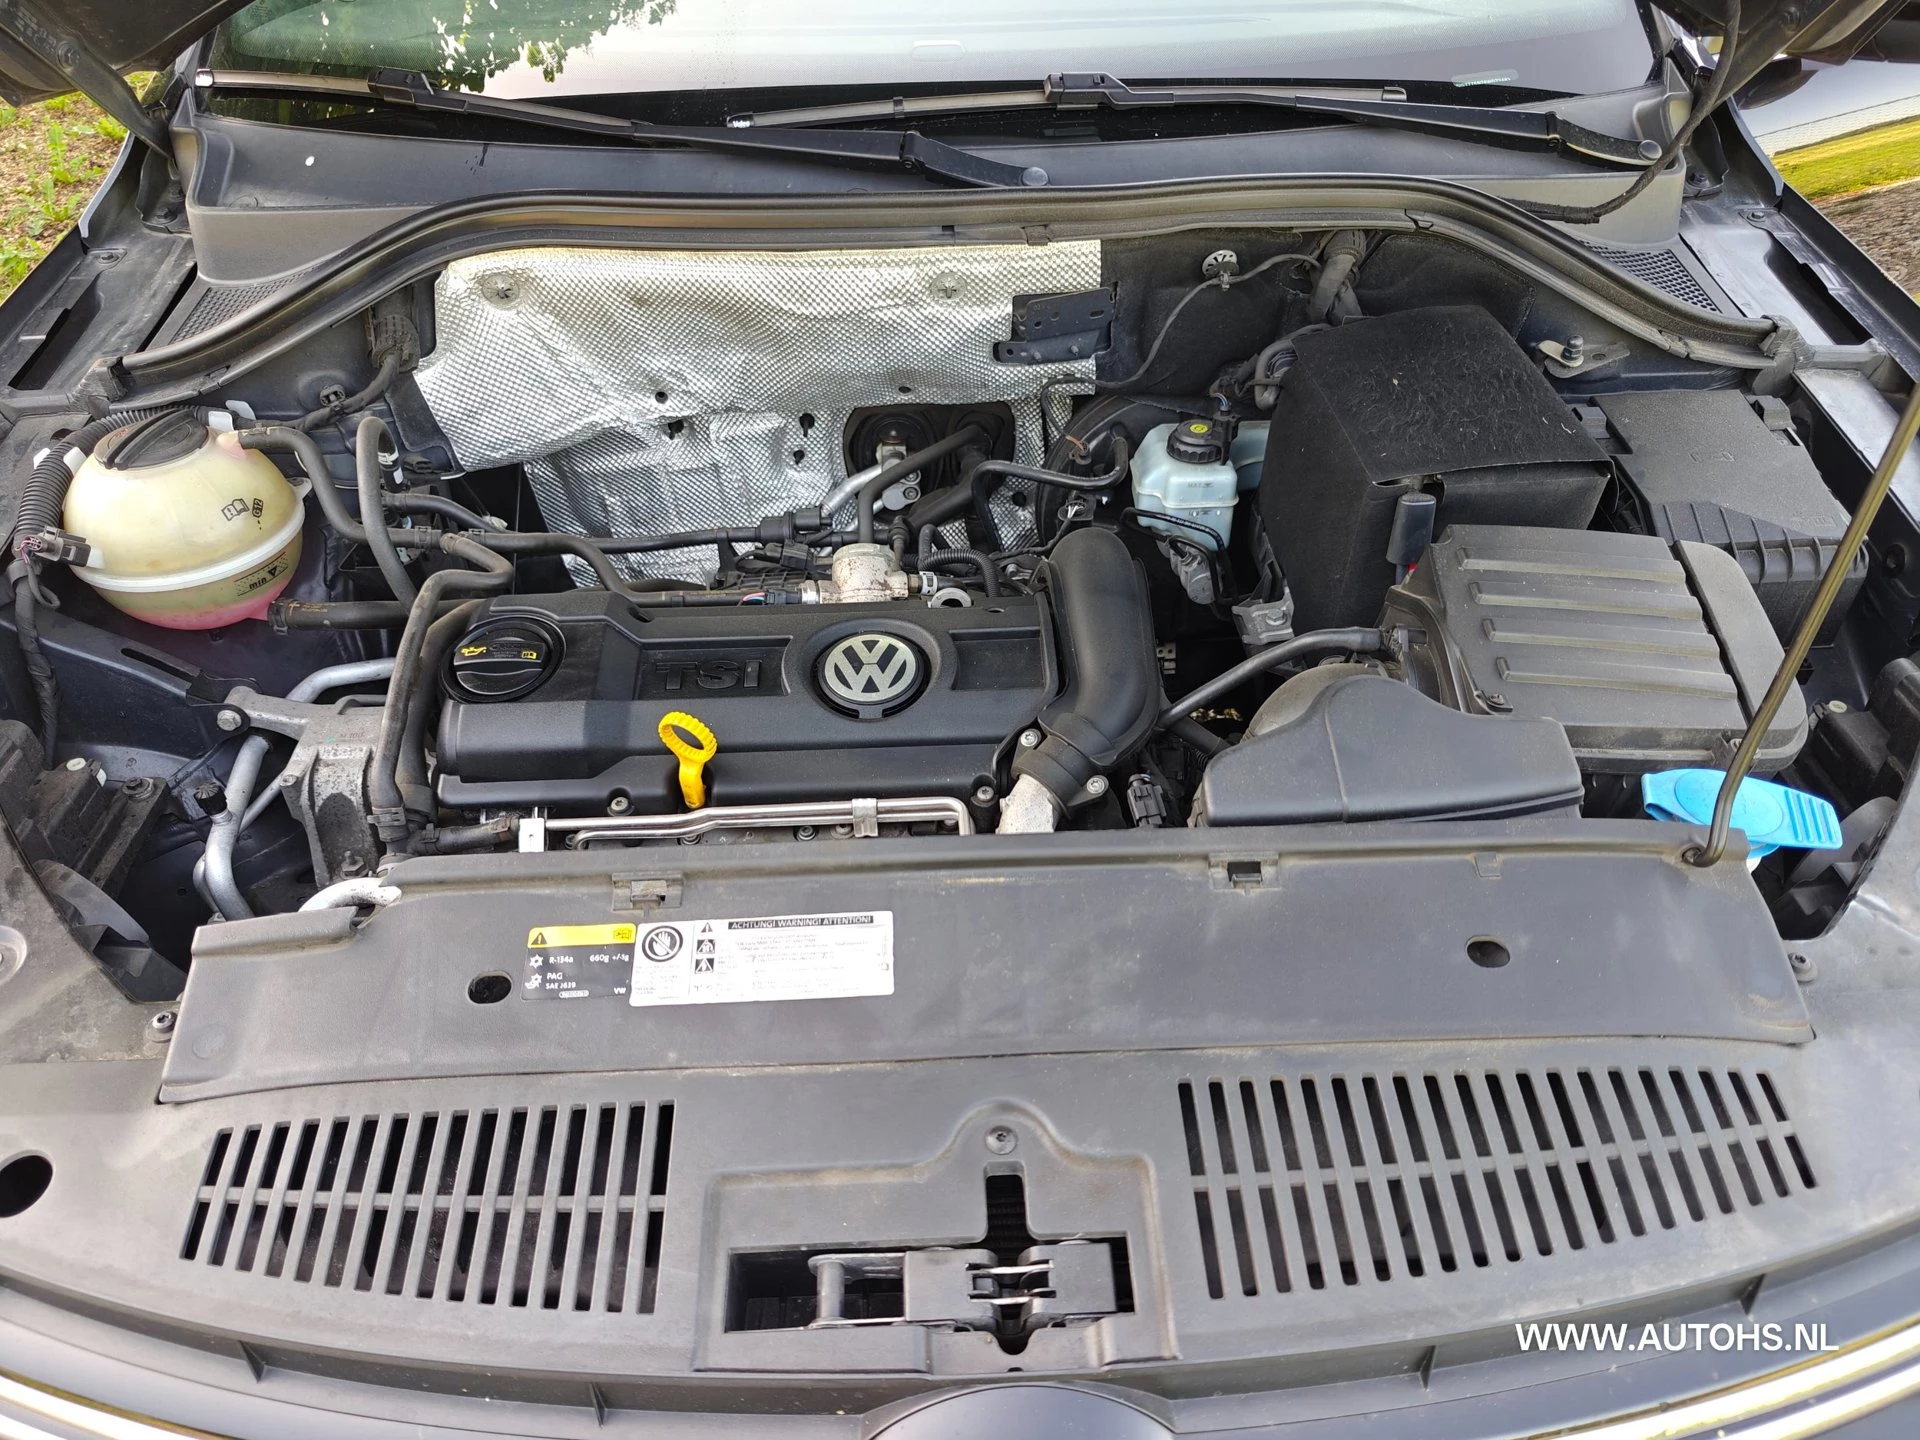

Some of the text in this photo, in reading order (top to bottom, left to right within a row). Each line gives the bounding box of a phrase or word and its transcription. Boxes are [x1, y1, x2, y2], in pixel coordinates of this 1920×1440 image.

[249, 577, 267, 590] min
[656, 660, 762, 690] TSI
[731, 915, 871, 929] ACHTUNG! WARNING! ATTENTION!
[549, 955, 574, 964] R-134a
[589, 954, 610, 963] 660g
[547, 972, 563, 980] PAG
[545, 982, 559, 990] SAE
[613, 987, 627, 995] VW
